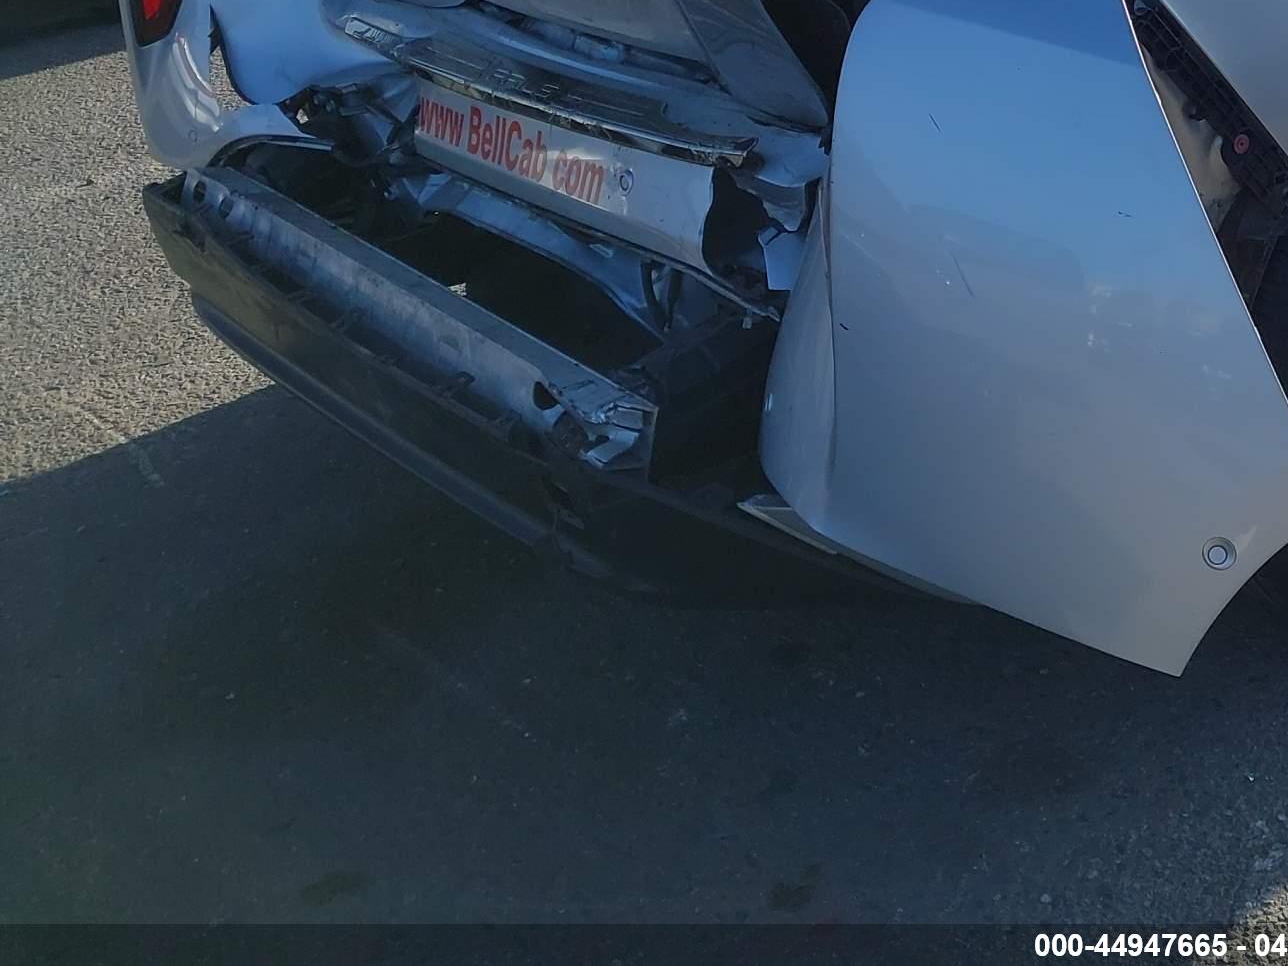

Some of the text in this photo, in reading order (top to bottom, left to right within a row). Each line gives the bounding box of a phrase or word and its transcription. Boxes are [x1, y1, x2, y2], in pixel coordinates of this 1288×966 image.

[419, 97, 604, 203] www BellCab com
